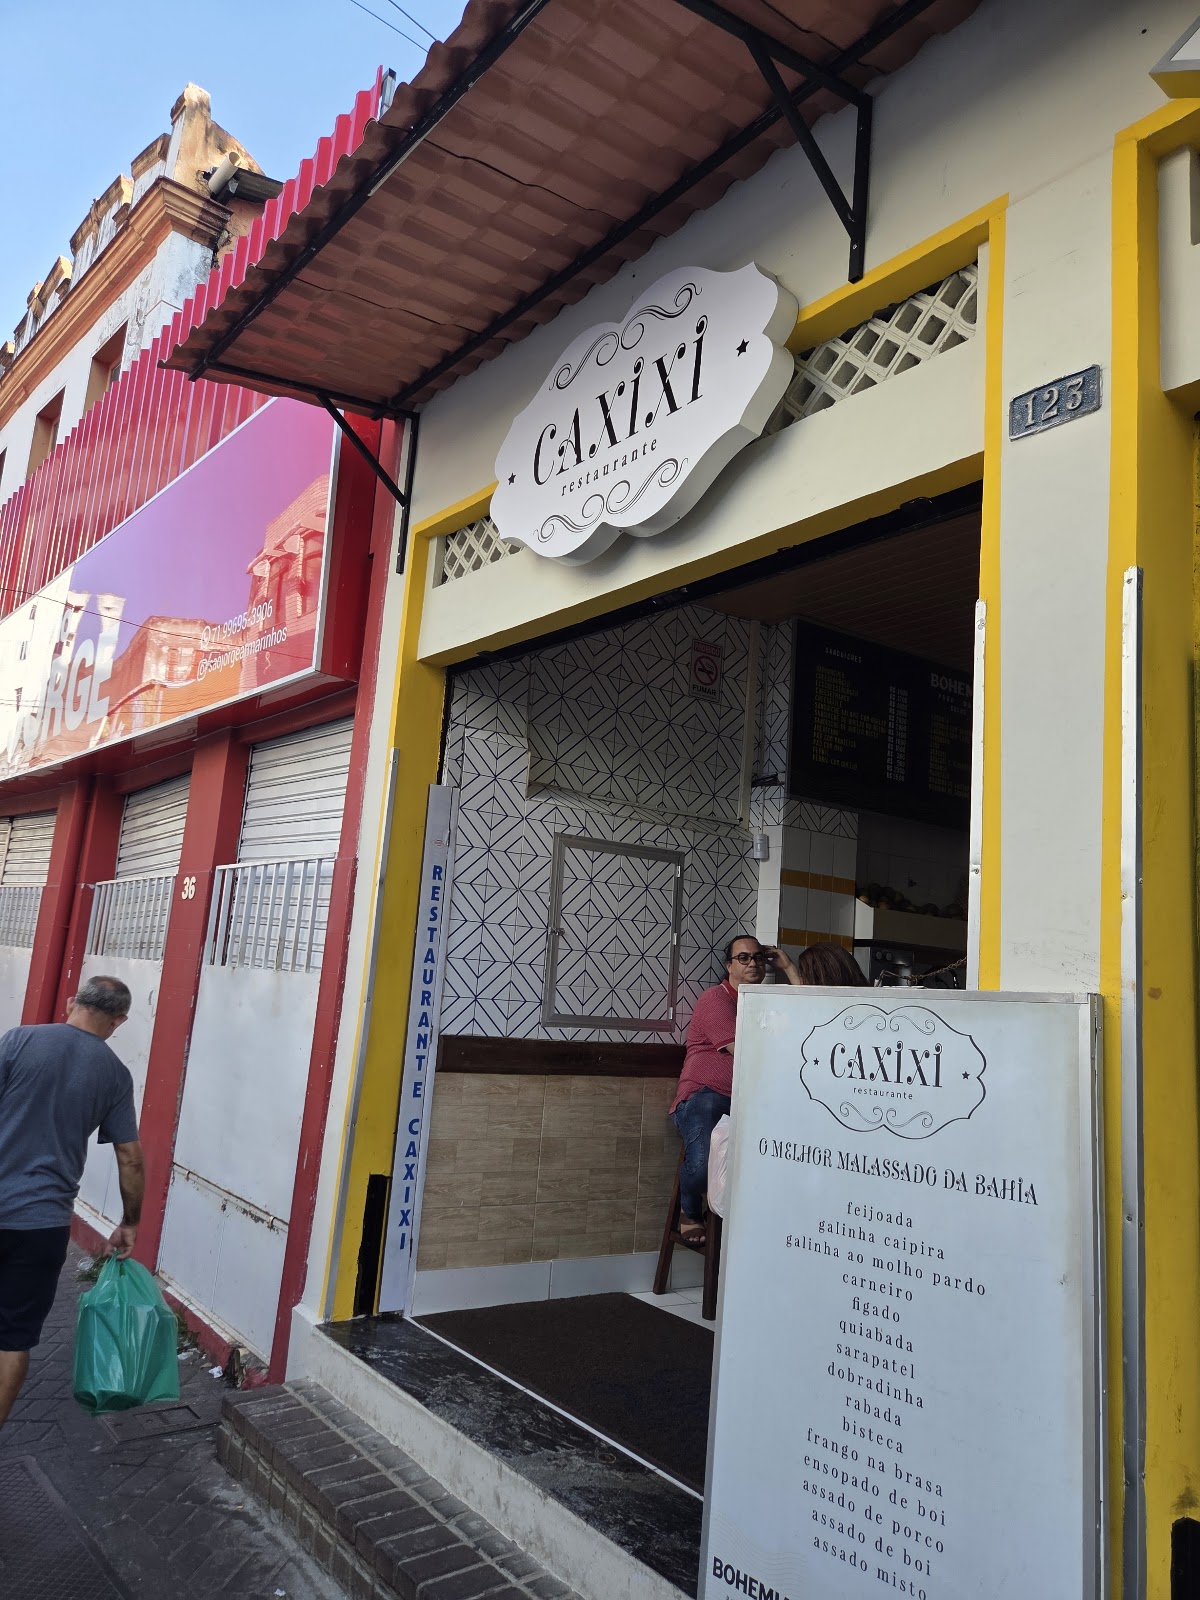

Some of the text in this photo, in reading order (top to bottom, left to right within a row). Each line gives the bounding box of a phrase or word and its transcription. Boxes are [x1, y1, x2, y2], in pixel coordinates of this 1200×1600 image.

[533, 315, 708, 486] CAXIXI
[1025, 376, 1085, 428] 123
[561, 438, 658, 497] restaurante
[212, 625, 221, 642] 71
[692, 684, 717, 696] FUMAR
[182, 876, 196, 900] 36
[412, 865, 443, 1098] RESTAURANTE
[830, 1040, 942, 1088] CAXIXI
[853, 1086, 913, 1100] restaurante
[399, 1119, 420, 1251] CAXIXI
[759, 1138, 1038, 1206] O MELHOR MALASSADO DA BAHIA
[848, 1202, 912, 1228] feijoada
[819, 1221, 944, 1259] galinha caipira
[786, 1235, 985, 1295] galinha ao molho pardo
[843, 1274, 912, 1301] carneiro
[840, 1321, 913, 1352] quiabada
[828, 1362, 923, 1408] dobradinha
[837, 1344, 914, 1379] sarapatel
[843, 1416, 903, 1453] bisteca
[846, 1396, 901, 1426] rabada
[808, 1428, 942, 1497] frango na brasa
[804, 1456, 945, 1526] ensopado de boi
[803, 1480, 943, 1552] assado de porco
[812, 1510, 930, 1576] assado de boi
[713, 1556, 789, 1600] BOHEM
[814, 1537, 926, 1600] assado misto
